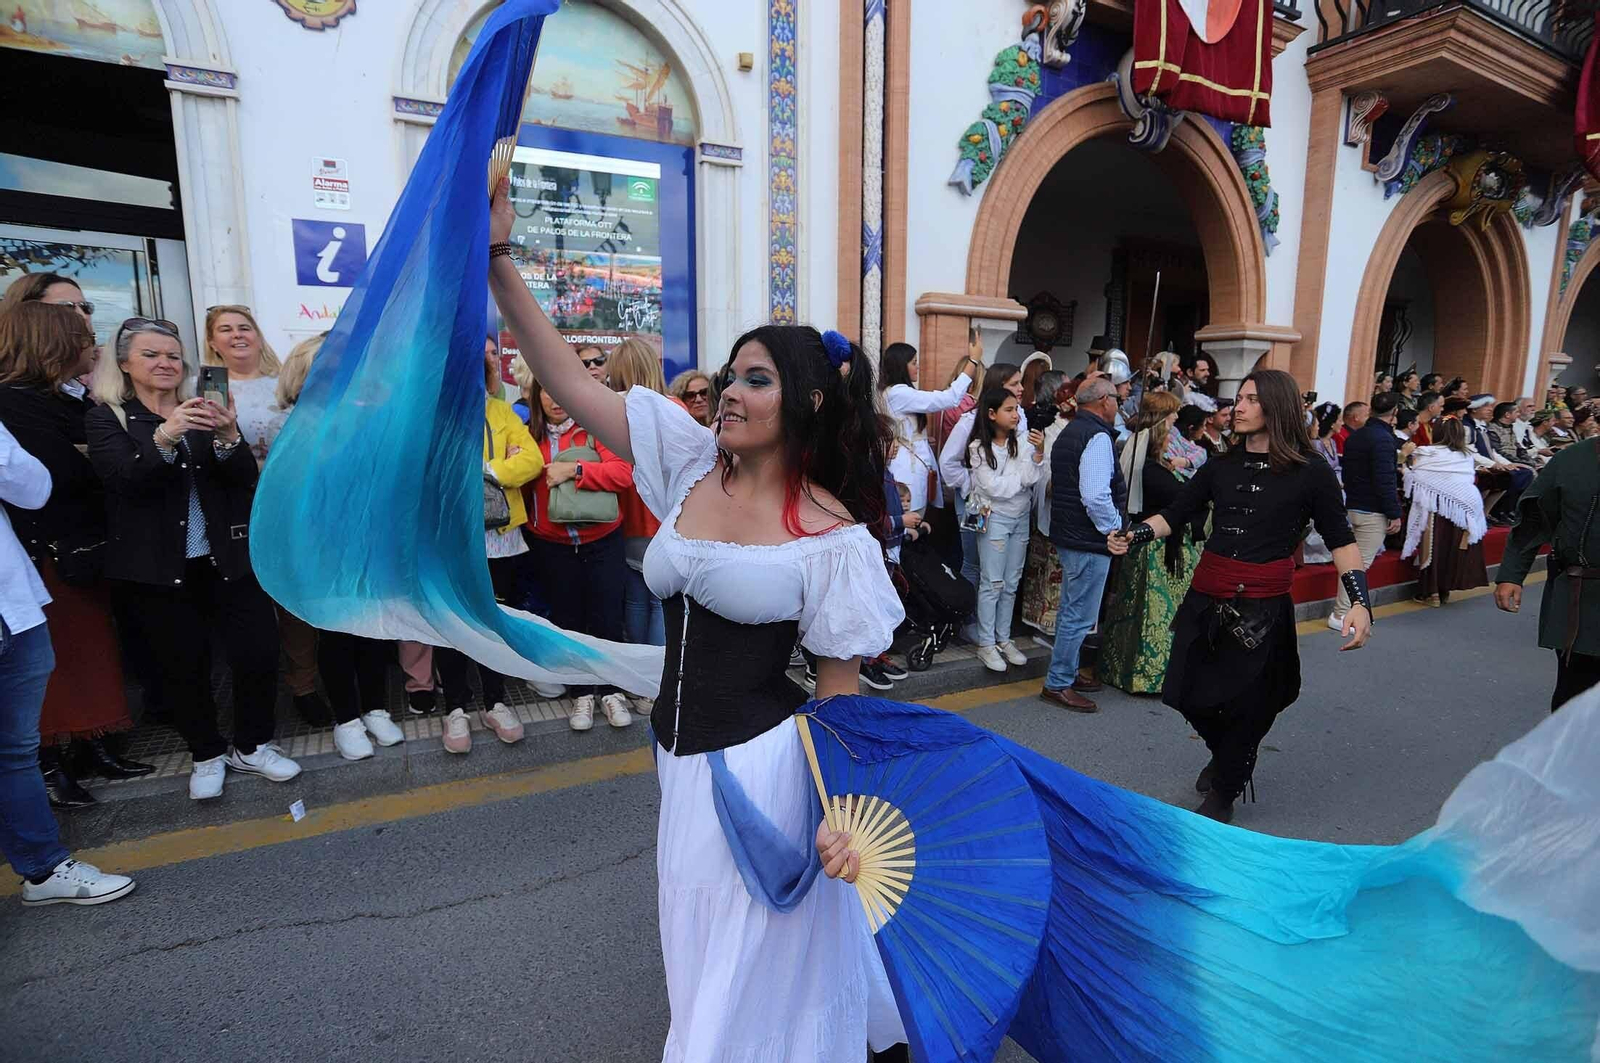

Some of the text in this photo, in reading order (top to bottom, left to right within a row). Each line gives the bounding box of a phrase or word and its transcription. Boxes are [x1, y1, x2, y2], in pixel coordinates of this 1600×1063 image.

[314, 178, 348, 188] Alarma
[544, 216, 613, 229] PLATAFORMA OTT
[527, 226, 632, 241] DE PALOS DE LA FRONTERA
[547, 273, 557, 281] LA
